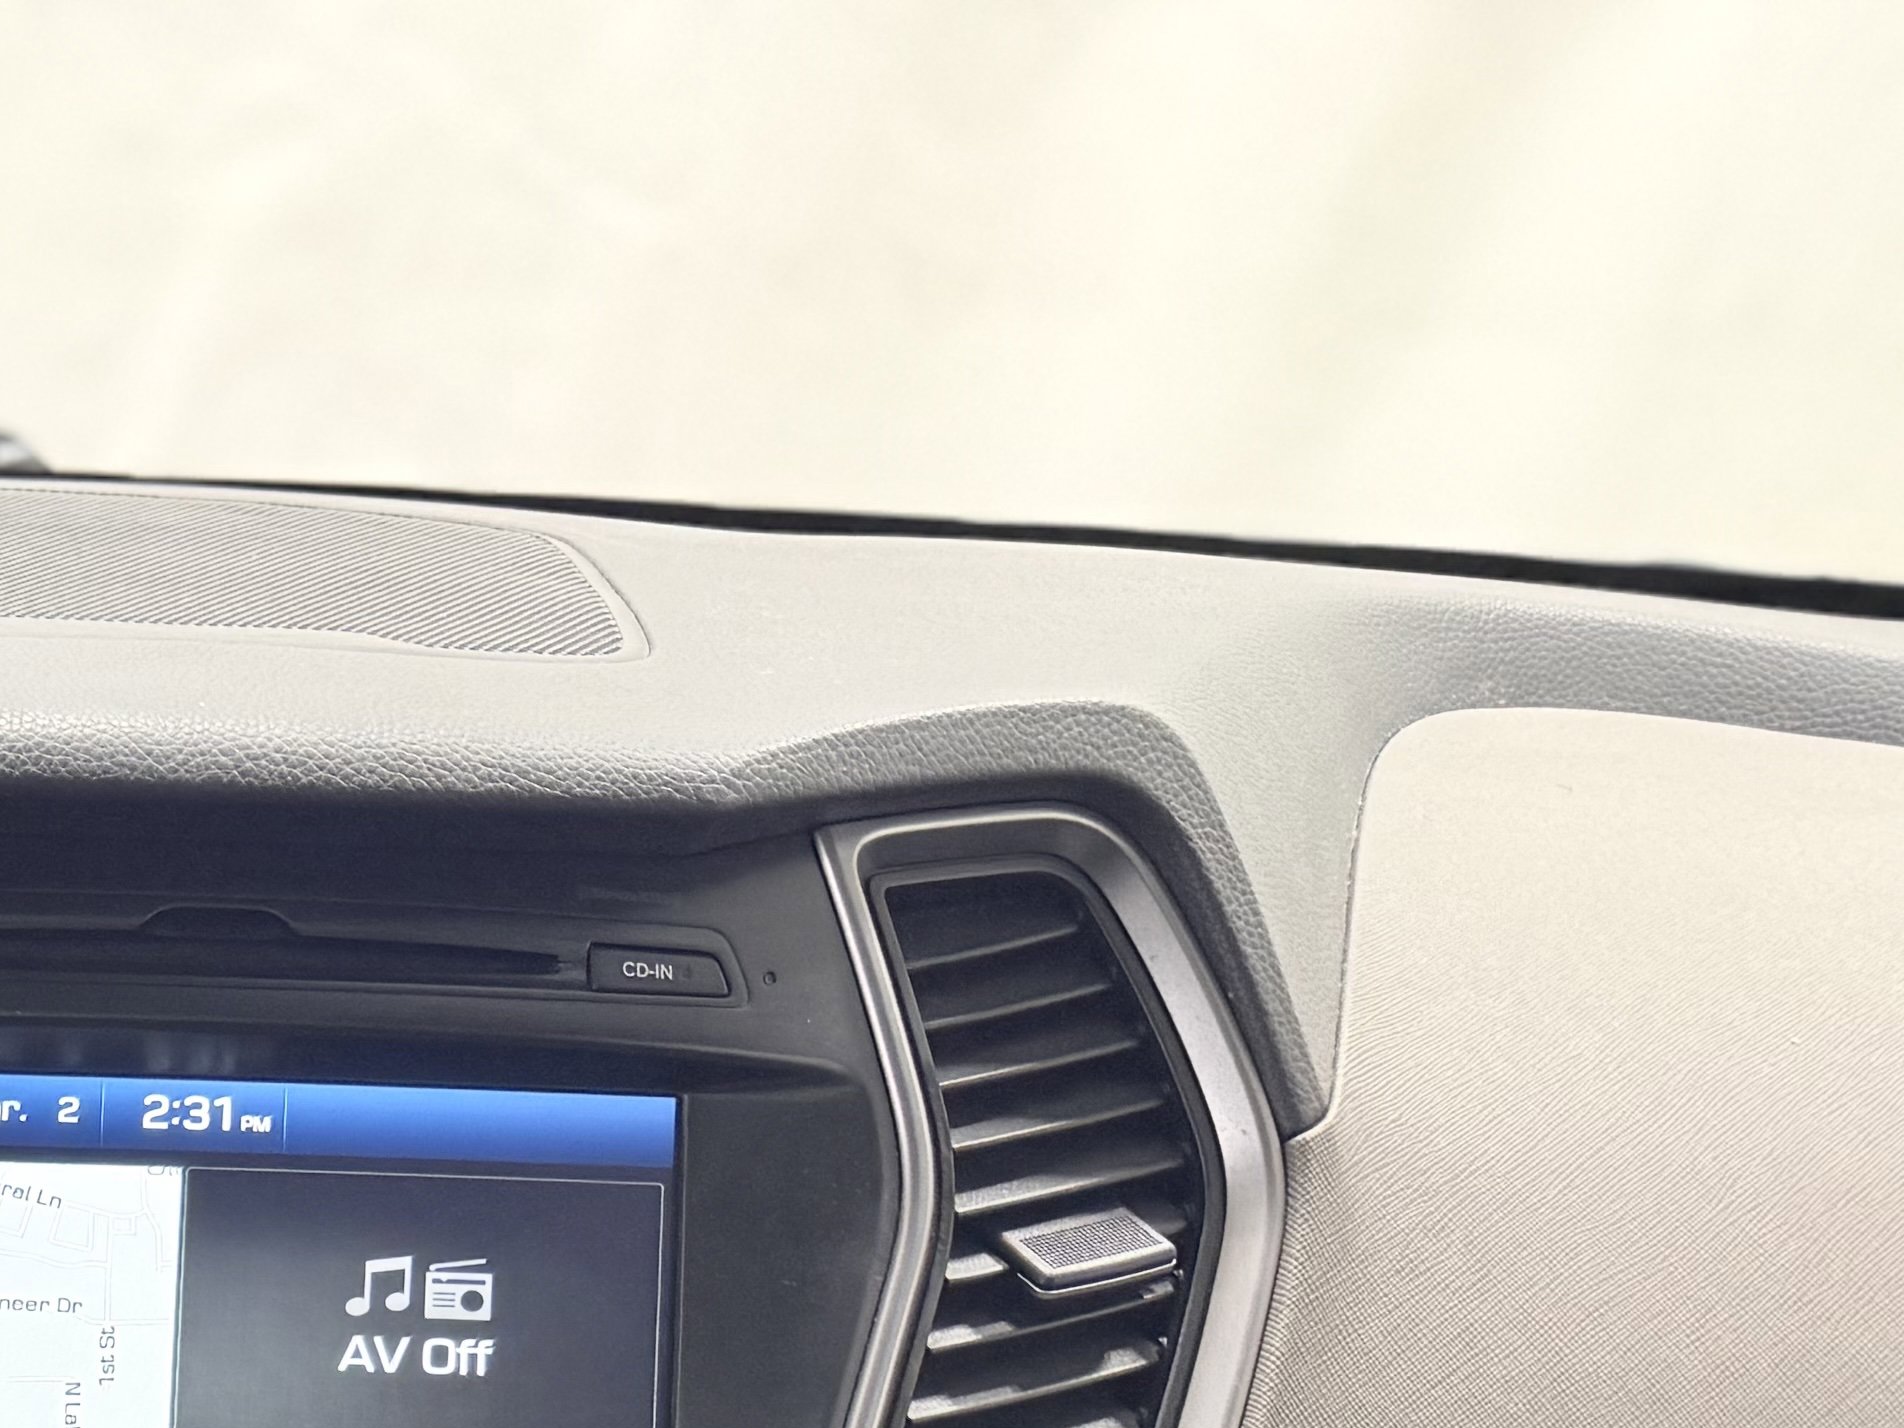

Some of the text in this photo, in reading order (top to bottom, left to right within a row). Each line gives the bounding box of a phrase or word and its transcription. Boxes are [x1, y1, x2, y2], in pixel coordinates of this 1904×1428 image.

[623, 961, 673, 980] CD-IN
[58, 1097, 80, 1124] 2
[142, 1094, 271, 1133] 2:31 PM
[37, 1189, 62, 1209] Ln
[58, 1297, 83, 1315] Dr
[99, 1326, 115, 1386] 1st St
[338, 1335, 495, 1377] AV Off
[65, 1382, 80, 1396] N
